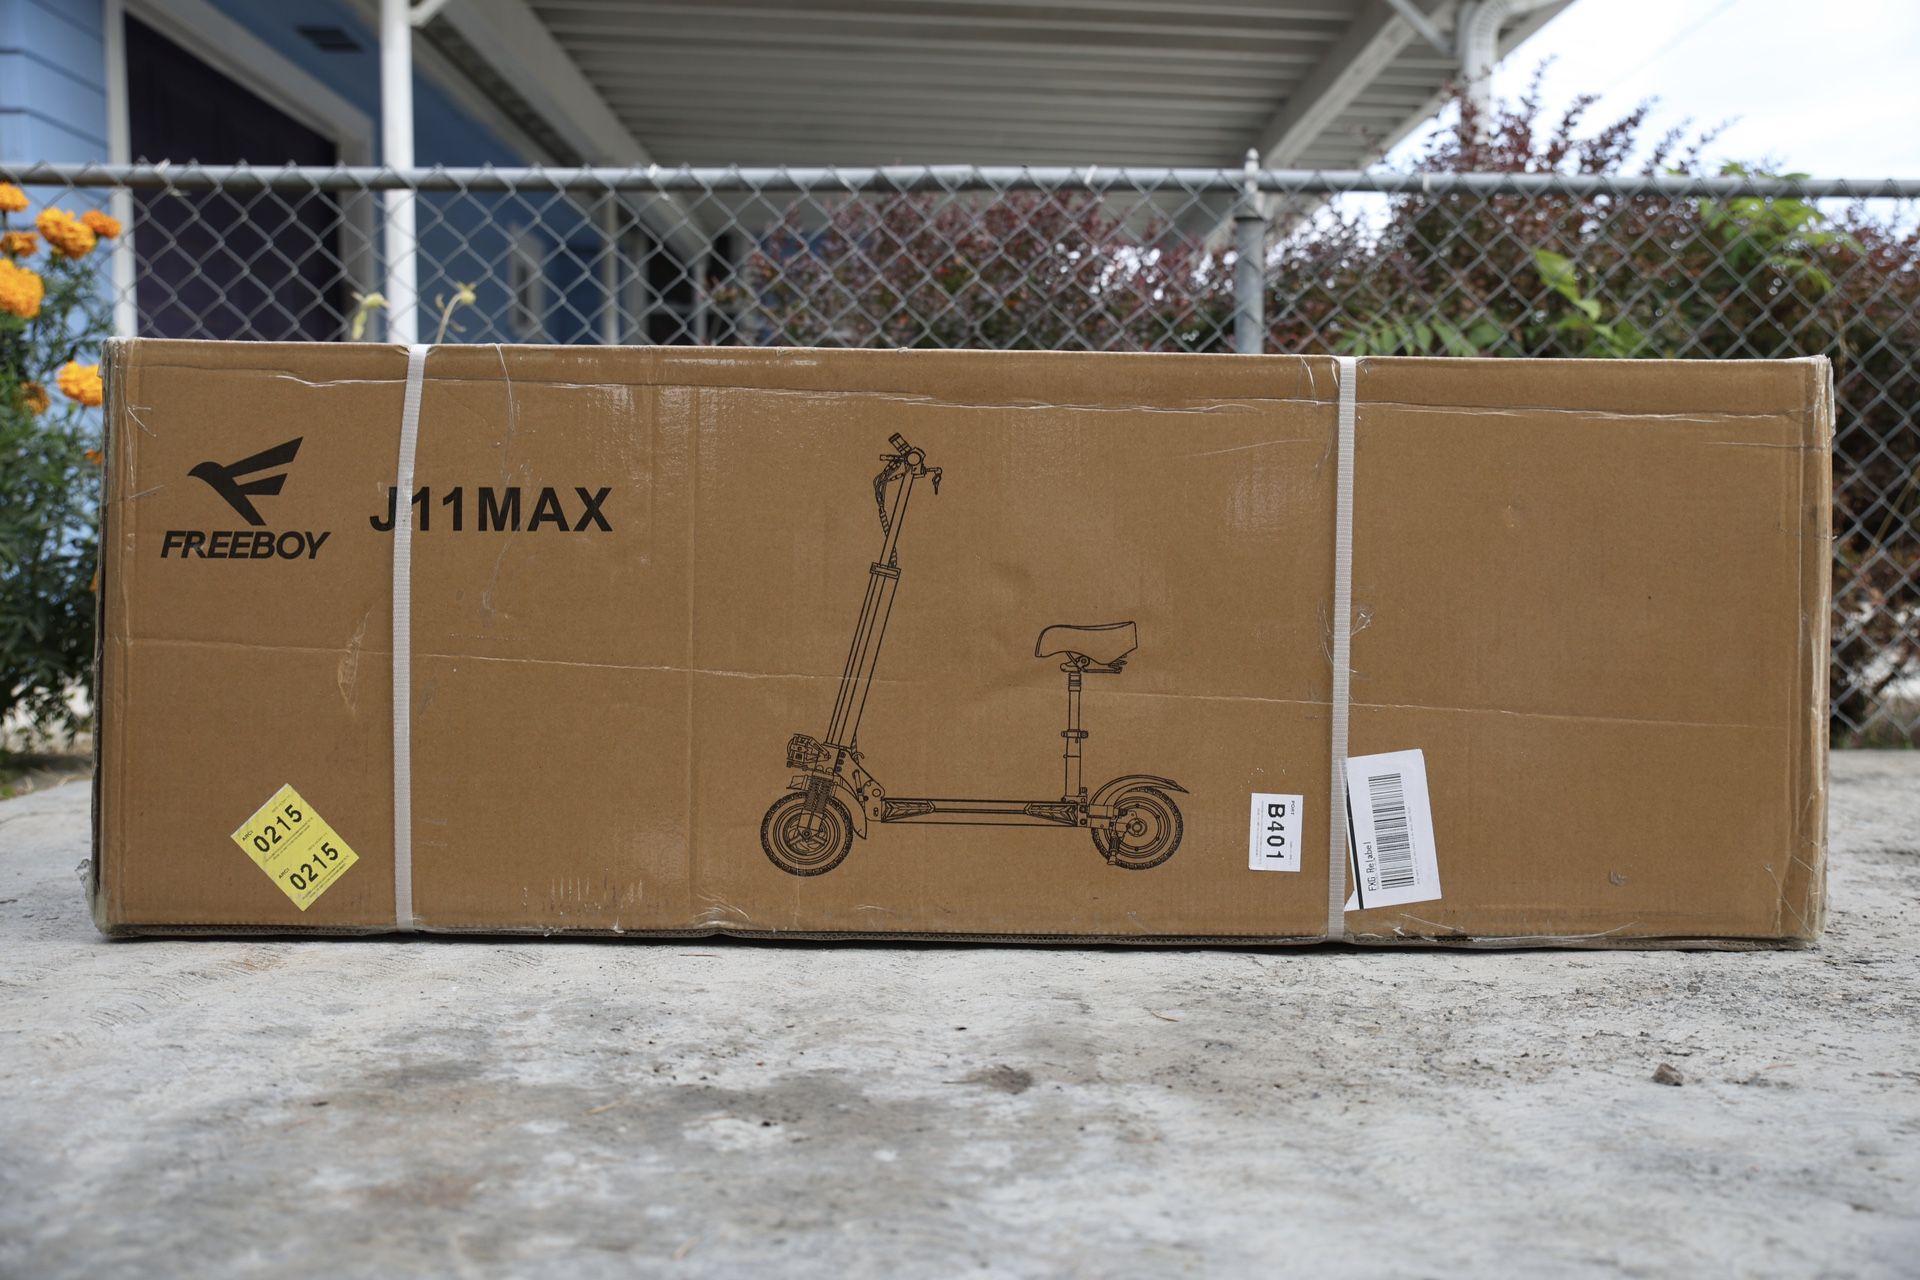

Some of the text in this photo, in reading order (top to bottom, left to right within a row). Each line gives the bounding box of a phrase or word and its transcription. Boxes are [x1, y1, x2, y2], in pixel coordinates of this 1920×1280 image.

[370, 487, 613, 532] J11MAX
[160, 531, 331, 560] FREEBOY
[253, 804, 302, 852] 0215
[1266, 803, 1286, 859] B401
[289, 842, 338, 890] 0215
[1363, 841, 1376, 874] Relabel
